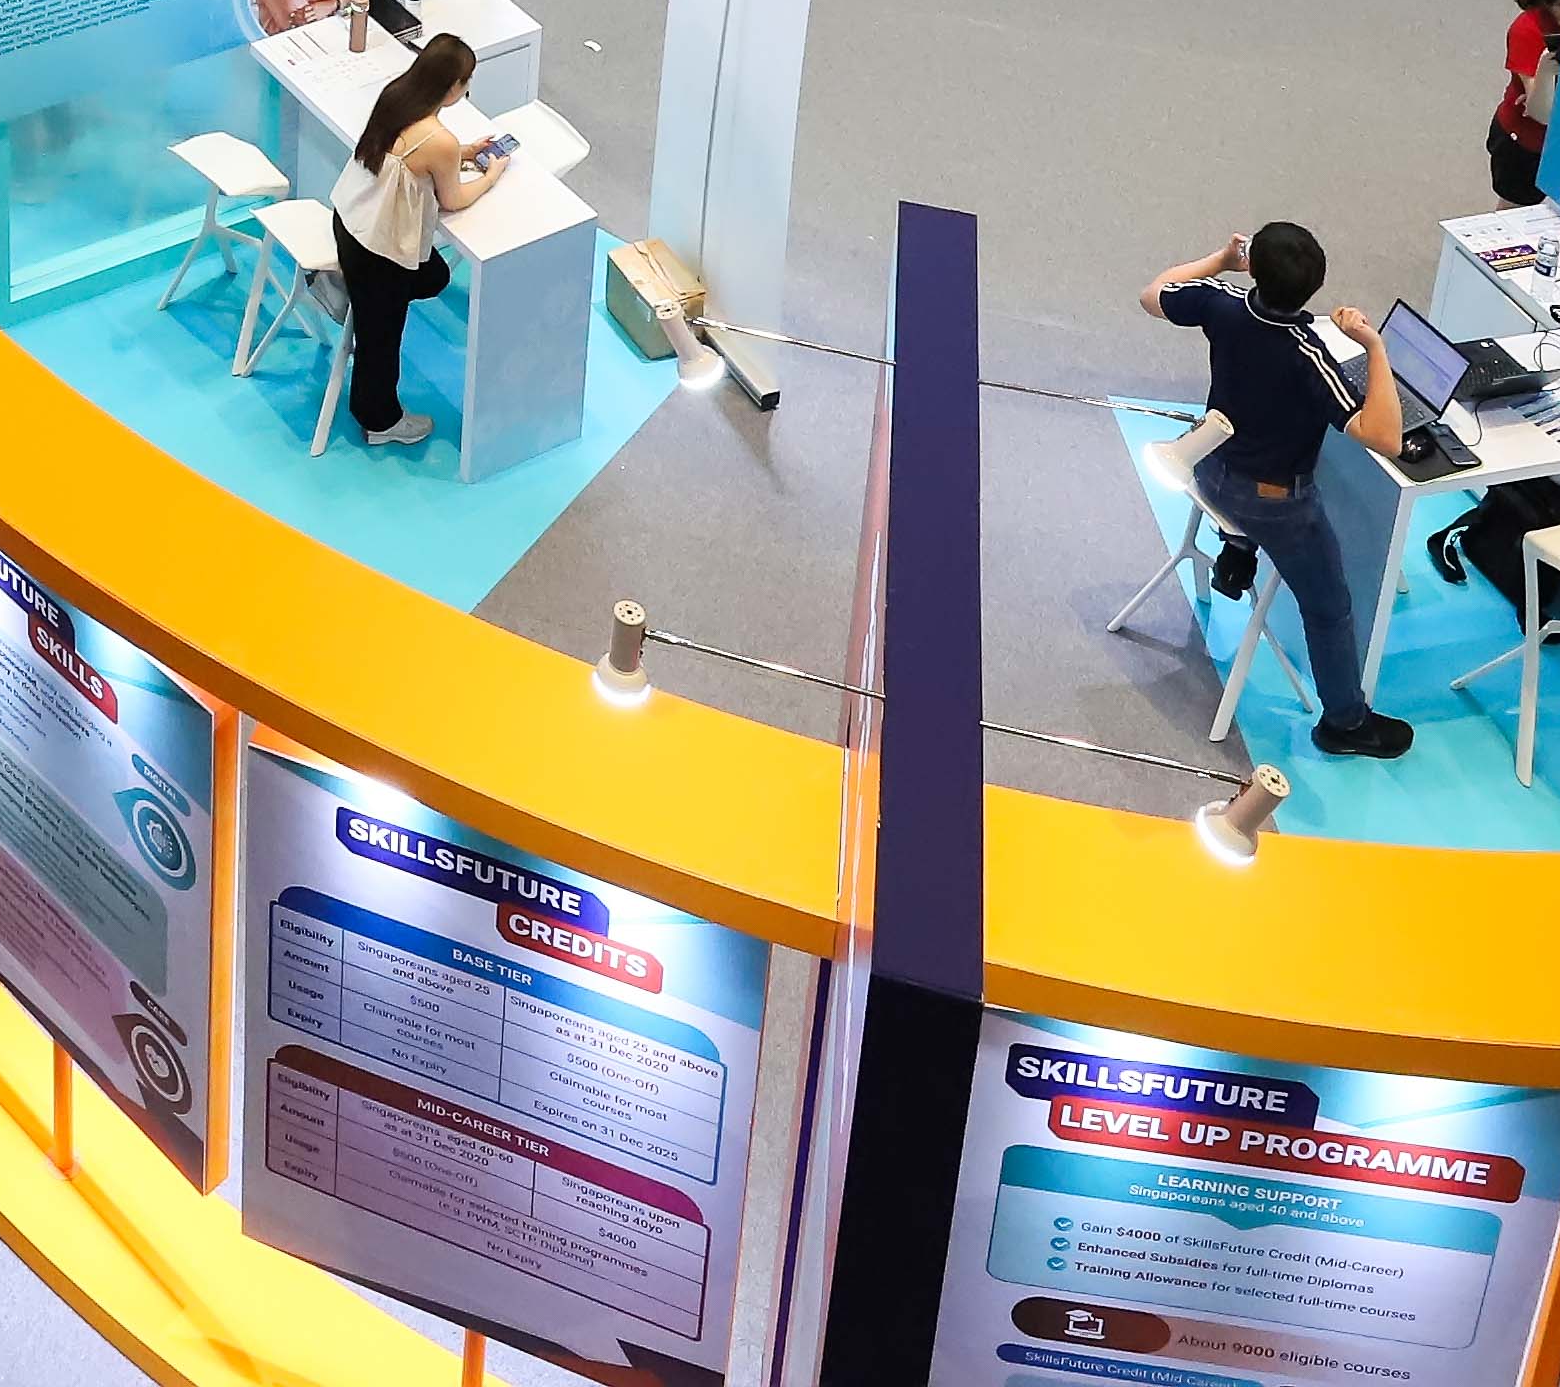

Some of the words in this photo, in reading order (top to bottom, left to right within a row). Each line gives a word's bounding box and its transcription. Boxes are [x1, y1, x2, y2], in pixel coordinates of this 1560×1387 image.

[36, 626, 103, 700] SKILLS
[347, 819, 581, 916] SKILLSFUTURE
[452, 948, 495, 970] BASE
[497, 960, 532, 986] TIER
[508, 913, 647, 978] CREDITS
[1016, 1056, 1288, 1114] SKILLSFUTURE
[417, 1097, 512, 1143] MID-CAREER
[514, 1133, 550, 1157] TIER
[1060, 1105, 1168, 1141] LEVEL
[1179, 1121, 1230, 1147] UP
[1240, 1129, 1491, 1186] PROGRAMME
[1157, 1172, 1250, 1197] LEARNING
[1253, 1187, 1342, 1211] SUPPORT
